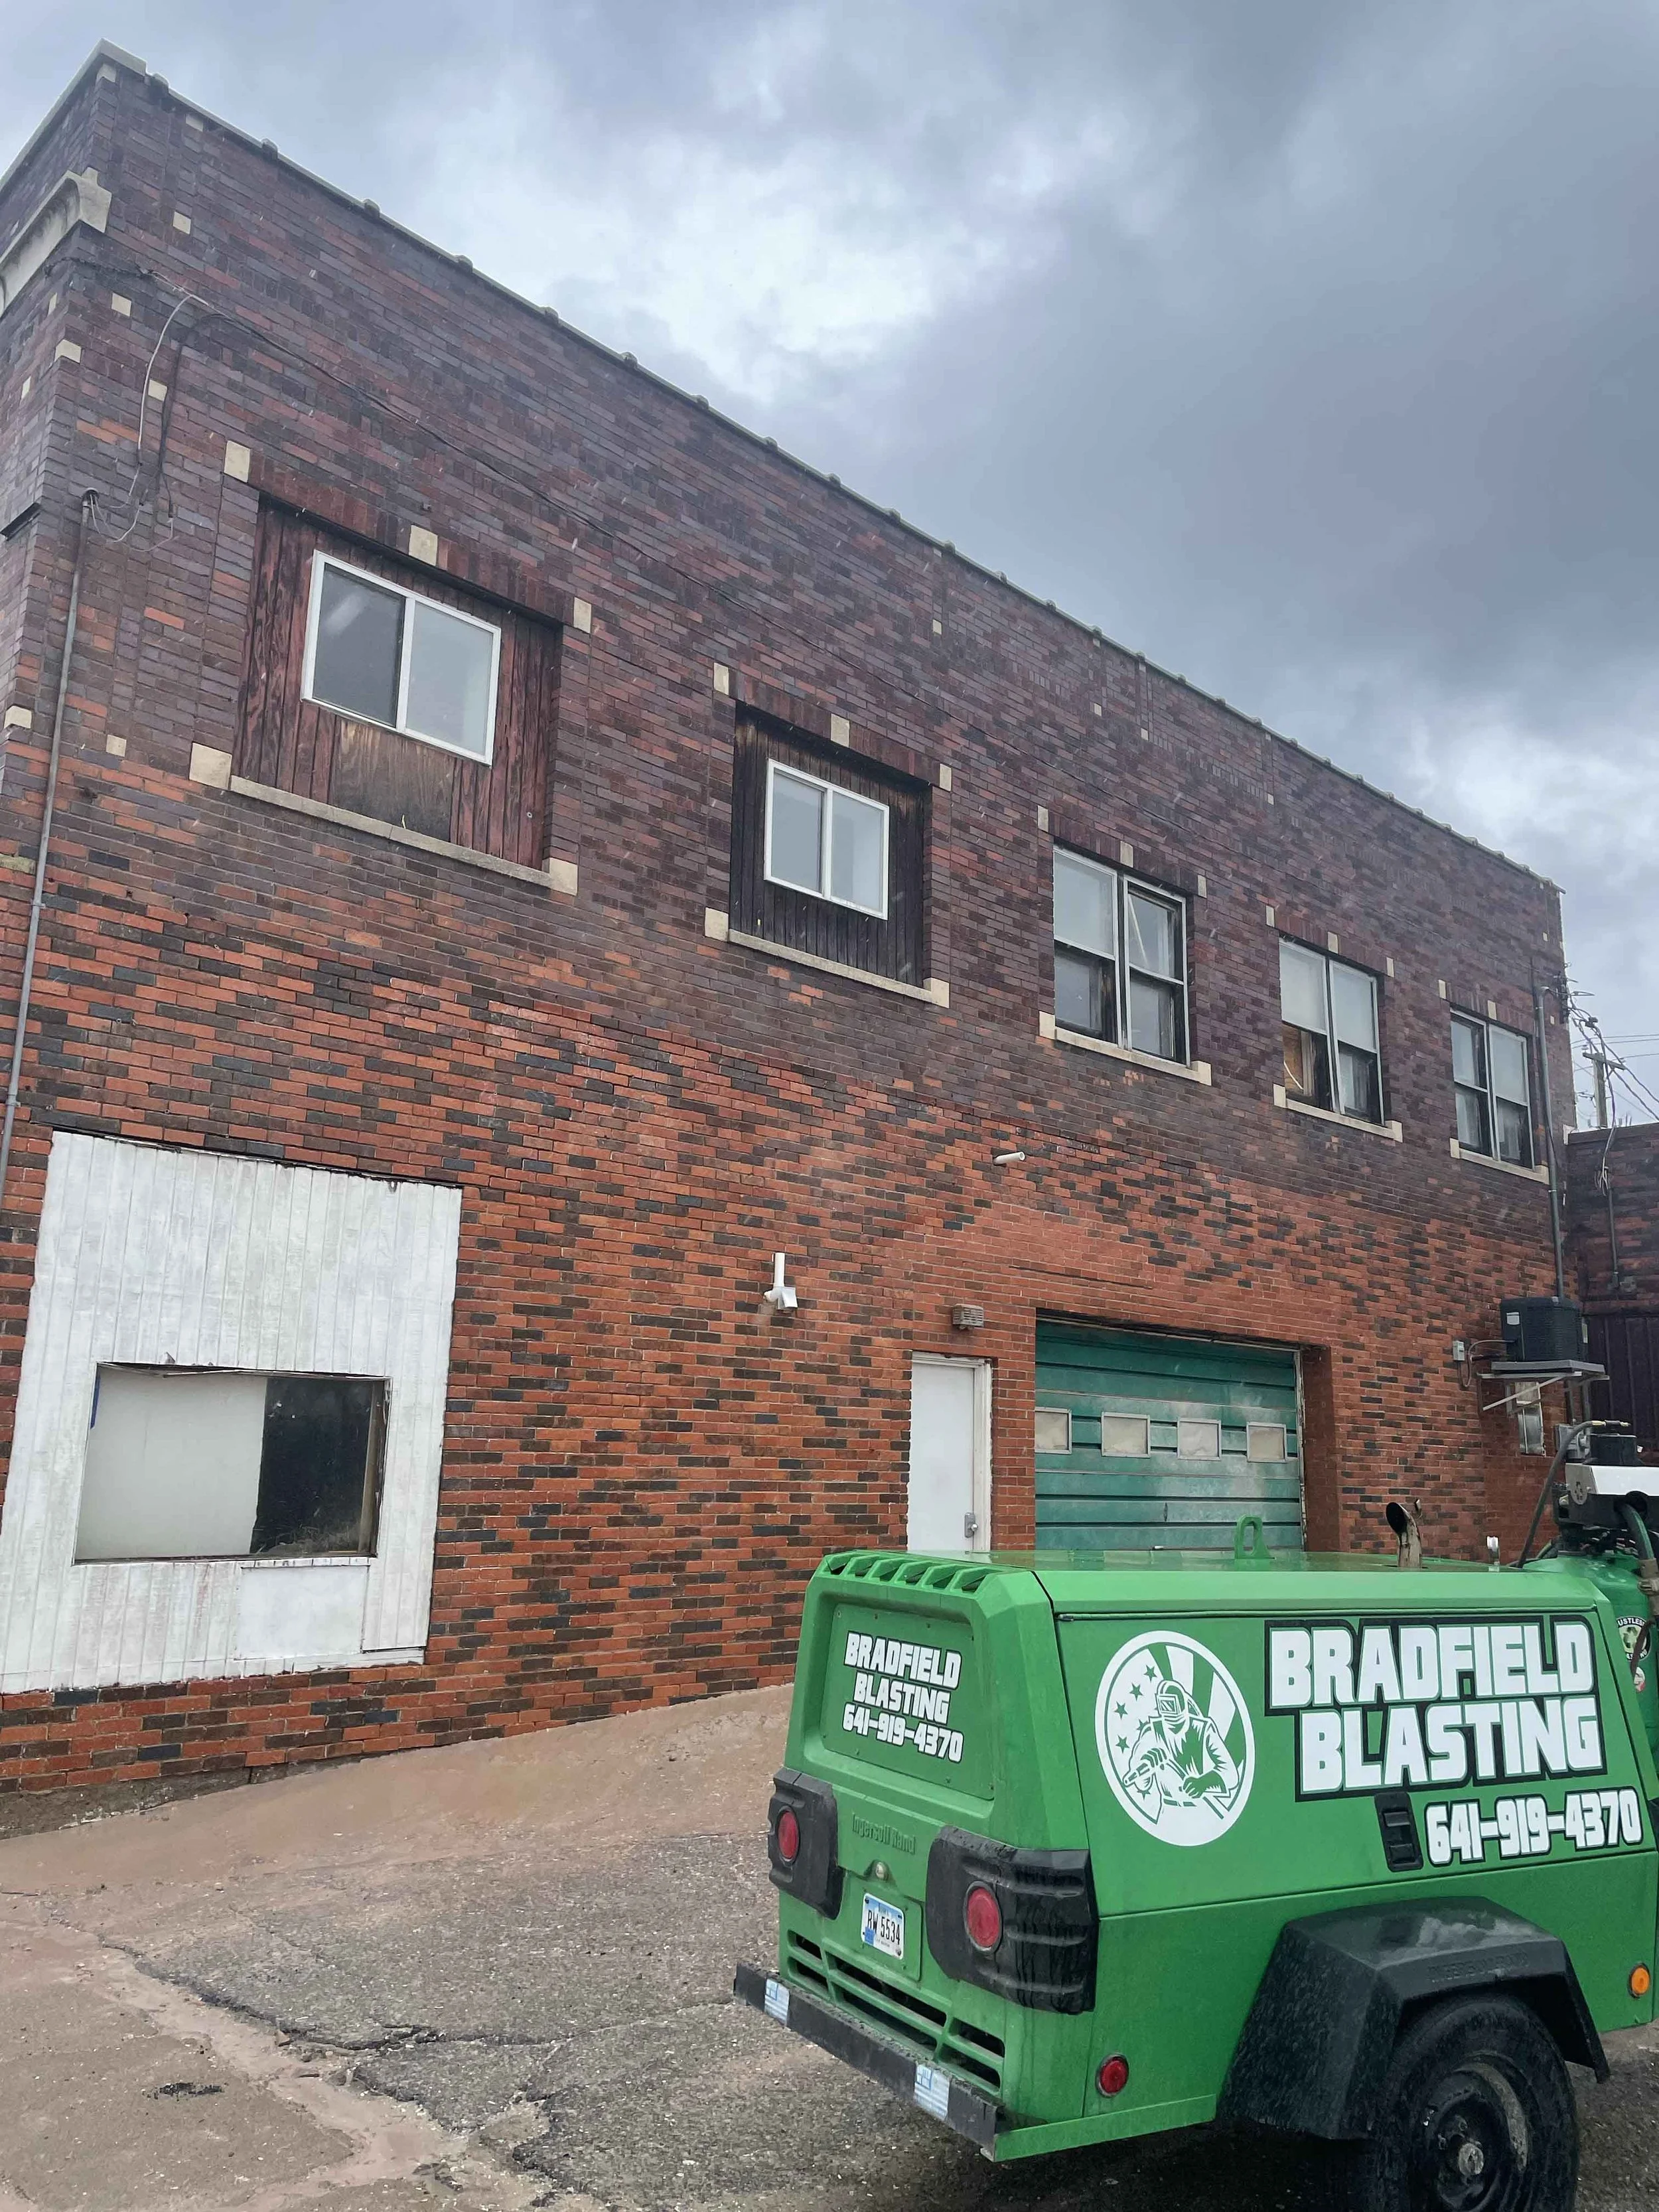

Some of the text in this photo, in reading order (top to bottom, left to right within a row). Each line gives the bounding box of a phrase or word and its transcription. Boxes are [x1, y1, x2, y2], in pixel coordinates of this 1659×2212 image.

[1617, 1617, 1645, 1627] USTLES
[845, 1631, 962, 1689] BRADFIELD
[1268, 1620, 1595, 1708] BRADFIELD
[853, 1672, 951, 1726] BLASTING
[843, 1702, 964, 1763] 641-919-4370
[1299, 1694, 1603, 1794] BLASTING
[1425, 1789, 1643, 1866] 641-919-4370
[881, 1916, 901, 1946] 5534
